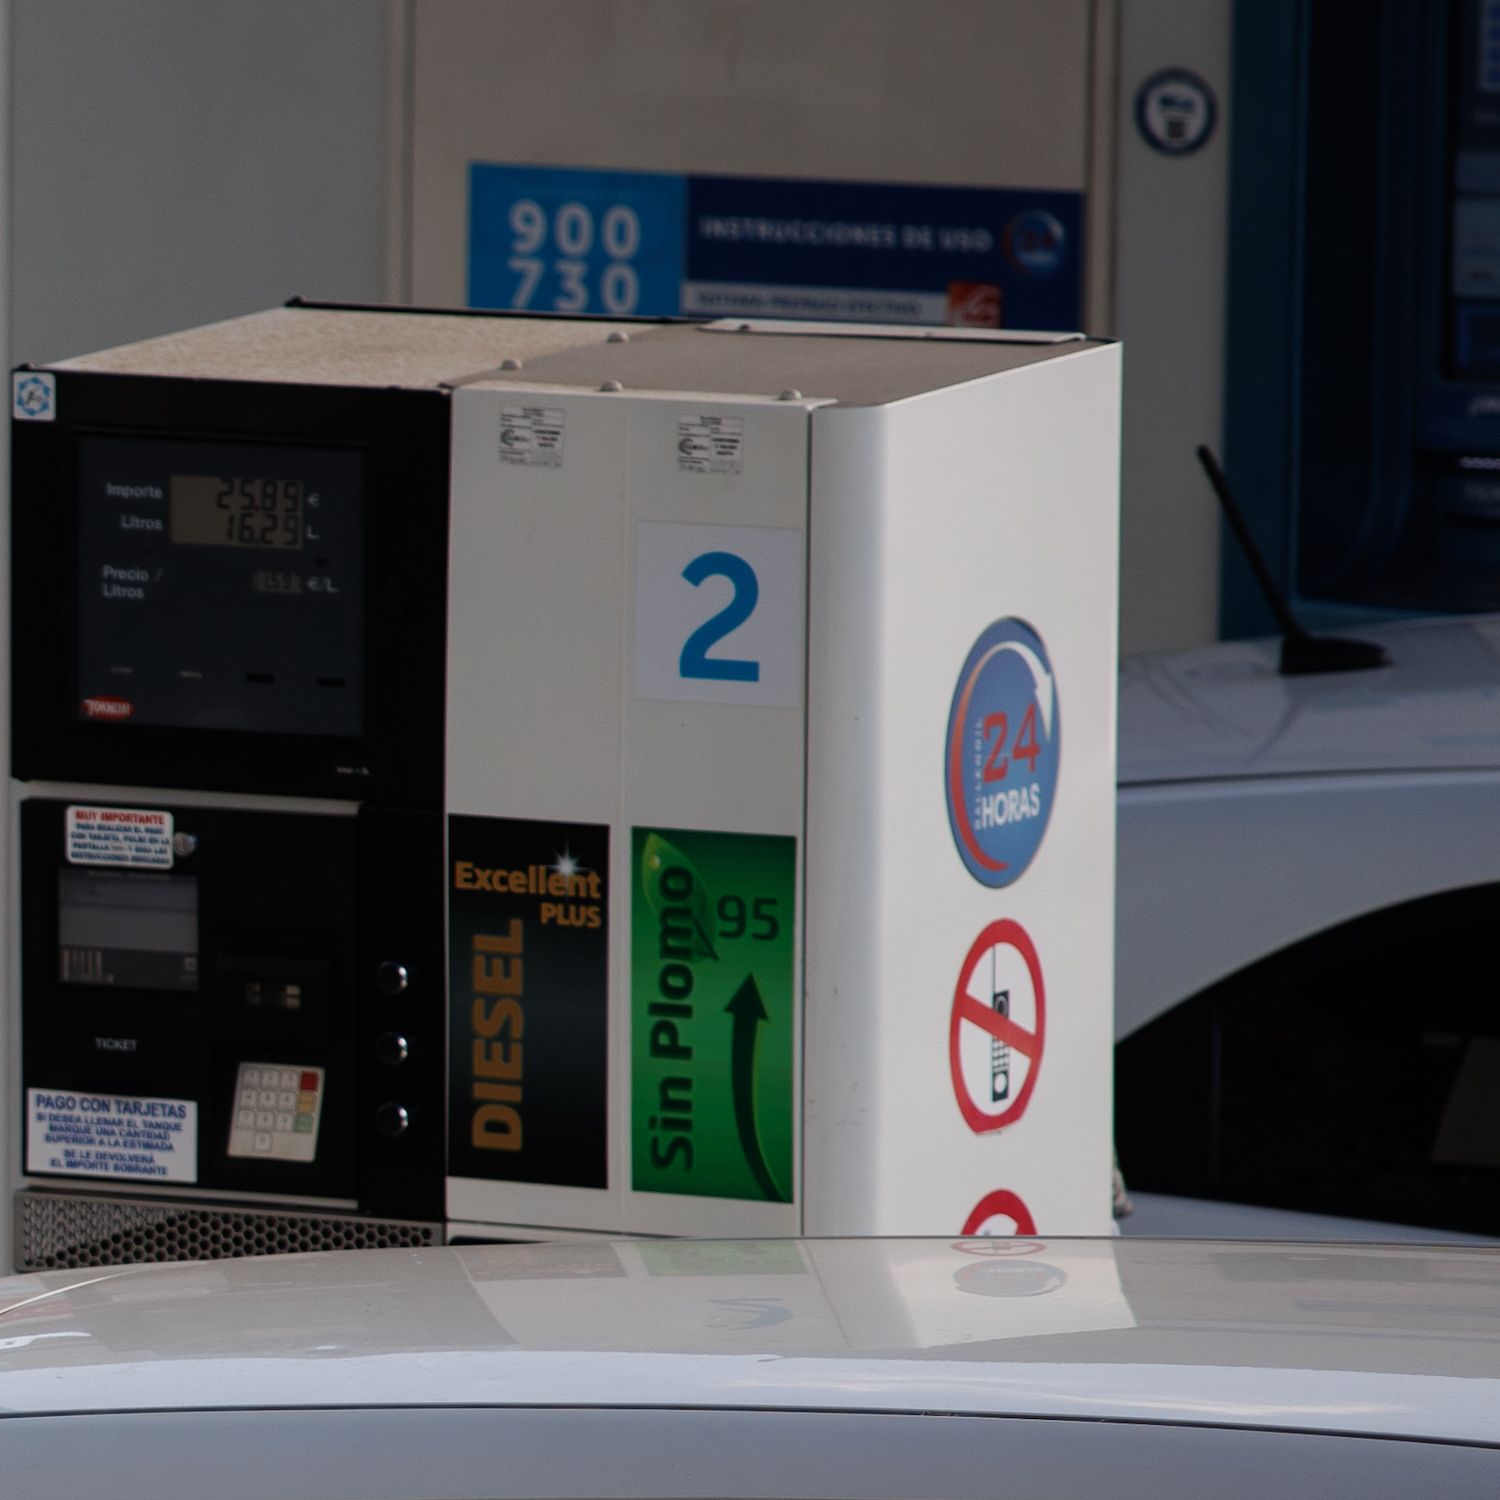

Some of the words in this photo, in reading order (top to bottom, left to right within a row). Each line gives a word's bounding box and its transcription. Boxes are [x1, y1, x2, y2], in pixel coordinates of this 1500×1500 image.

[509, 200, 640, 258] 900
[699, 216, 895, 249] INSTRUCCIONES
[902, 225, 934, 250] DE
[939, 227, 993, 254] USO
[509, 258, 640, 314] 730
[107, 482, 163, 501] Importe
[121, 515, 163, 531] Litros
[103, 566, 149, 582] Precio
[103, 583, 144, 600] Litros
[679, 551, 759, 682] 2
[983, 703, 1040, 784] 24
[75, 810, 97, 821] MUY
[101, 811, 165, 825] IMPORTANTE
[981, 783, 1040, 829] HORAS
[454, 861, 601, 899] Excellent
[540, 902, 601, 929] PLUS
[717, 894, 779, 941] 95
[648, 866, 694, 1061] Plomo
[95, 1037, 137, 1052] TICKET
[471, 919, 524, 1151] DIESEL
[36, 1093, 76, 1110] PAGO
[80, 1096, 111, 1113] CON
[115, 1100, 187, 1119] TARJETAS
[49, 1113, 82, 1124] DESEA
[85, 1116, 124, 1127] LLENAR
[142, 1120, 182, 1132] TANQUE
[649, 1077, 693, 1172] Sin
[108, 1138, 120, 1147] LA
